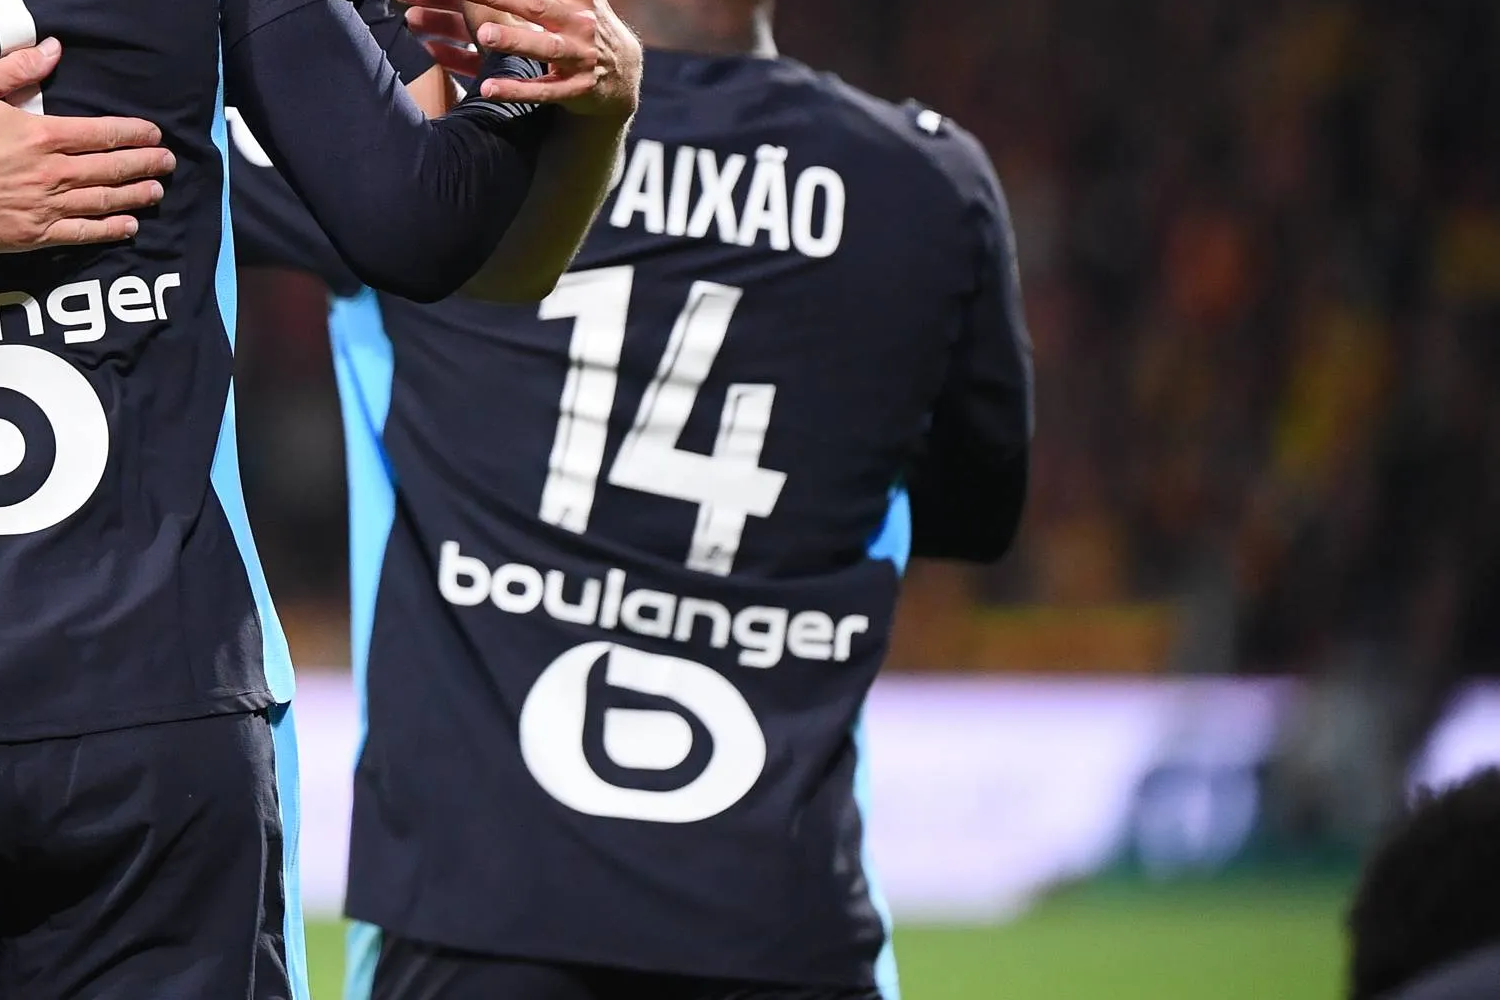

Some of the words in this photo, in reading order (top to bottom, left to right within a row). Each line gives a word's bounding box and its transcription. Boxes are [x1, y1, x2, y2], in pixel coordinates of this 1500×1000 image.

[606, 138, 846, 258] AIXÃO
[538, 265, 787, 577] 14
[438, 540, 869, 669] boulanger
